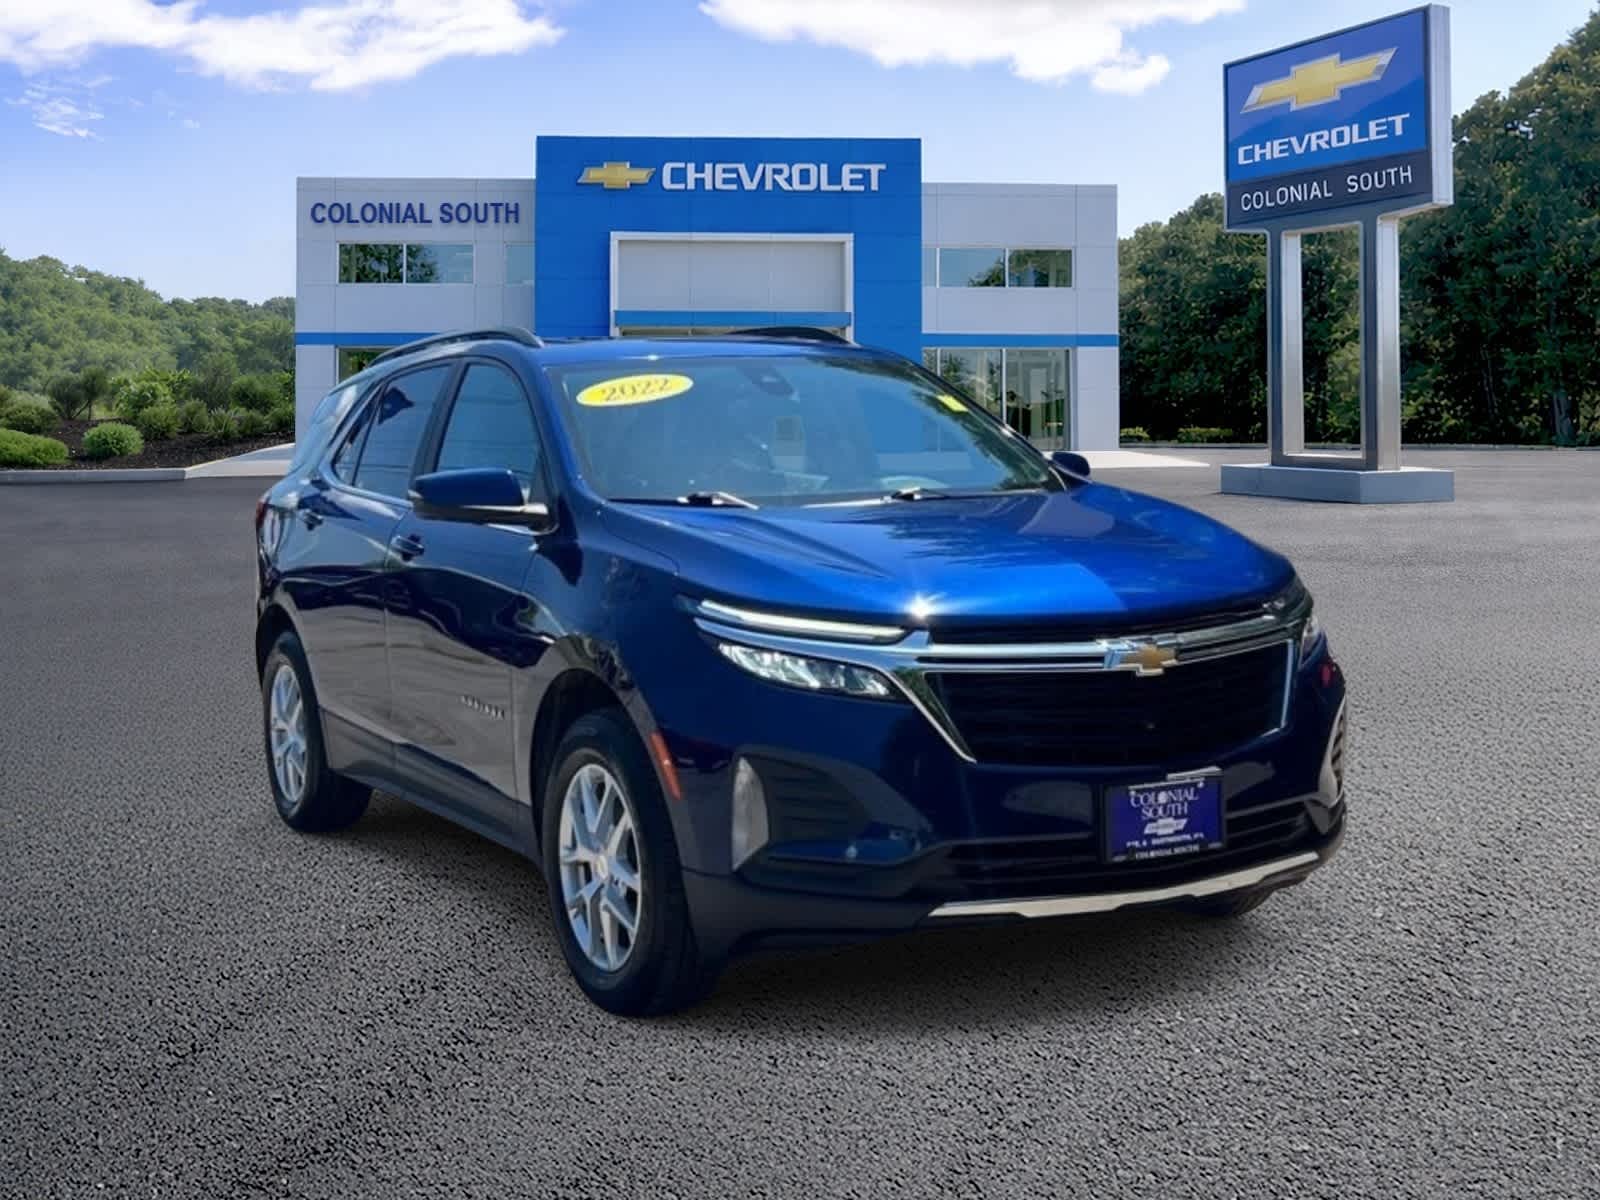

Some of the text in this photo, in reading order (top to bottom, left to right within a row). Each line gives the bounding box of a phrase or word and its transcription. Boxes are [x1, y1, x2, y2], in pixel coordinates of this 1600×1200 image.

[1238, 113, 1410, 165] CHEVROLET
[662, 162, 886, 192] CHEVROLET
[1240, 165, 1413, 211] COLONIAL SOUTH
[310, 202, 519, 224] COLONIAL SOUTH
[603, 378, 669, 401] 2022
[1130, 787, 1199, 808] COLONIAL
[1141, 802, 1188, 820] SOUTH
